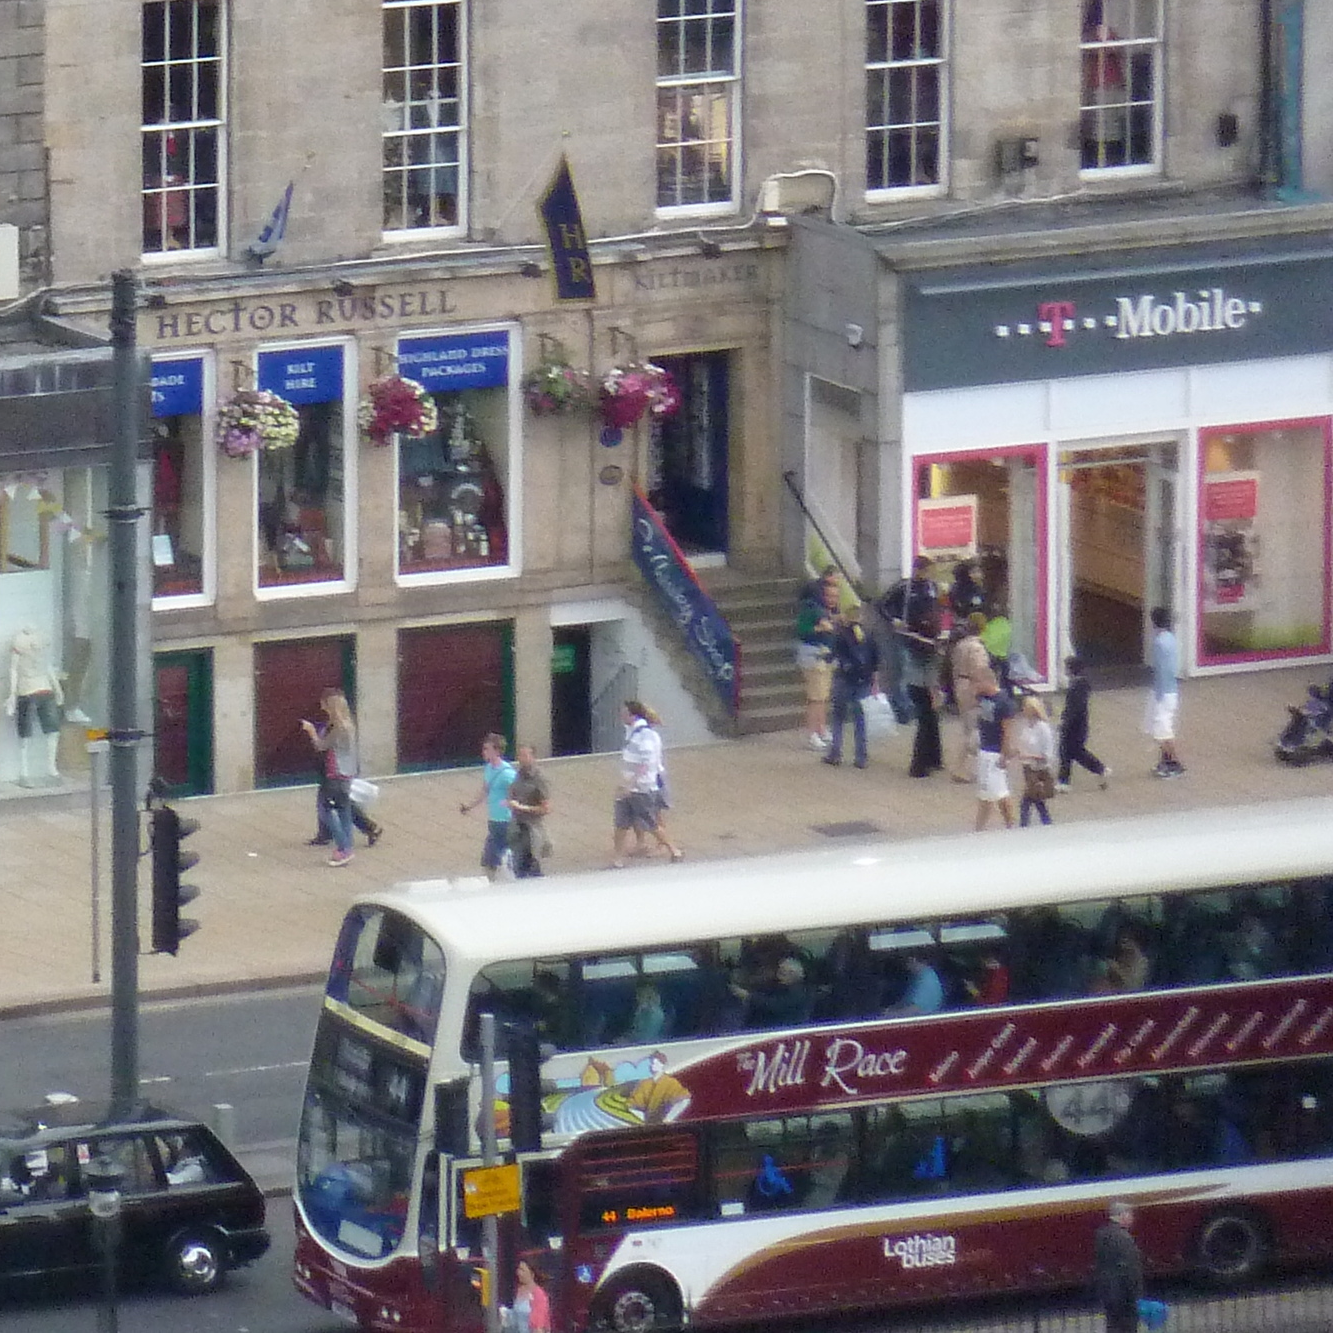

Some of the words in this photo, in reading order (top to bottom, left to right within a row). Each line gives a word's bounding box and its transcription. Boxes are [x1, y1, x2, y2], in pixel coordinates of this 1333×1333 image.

[157, 300, 299, 340] HECTOR
[316, 290, 457, 326] RUSSELL
[287, 362, 316, 374] KILT
[285, 377, 317, 390] HIRE
[746, 1039, 811, 1097] Mill
[820, 1038, 908, 1095] Race
[626, 1206, 676, 1220] Balerno
[884, 1233, 956, 1258] Lothian
[902, 1248, 956, 1269] buses
